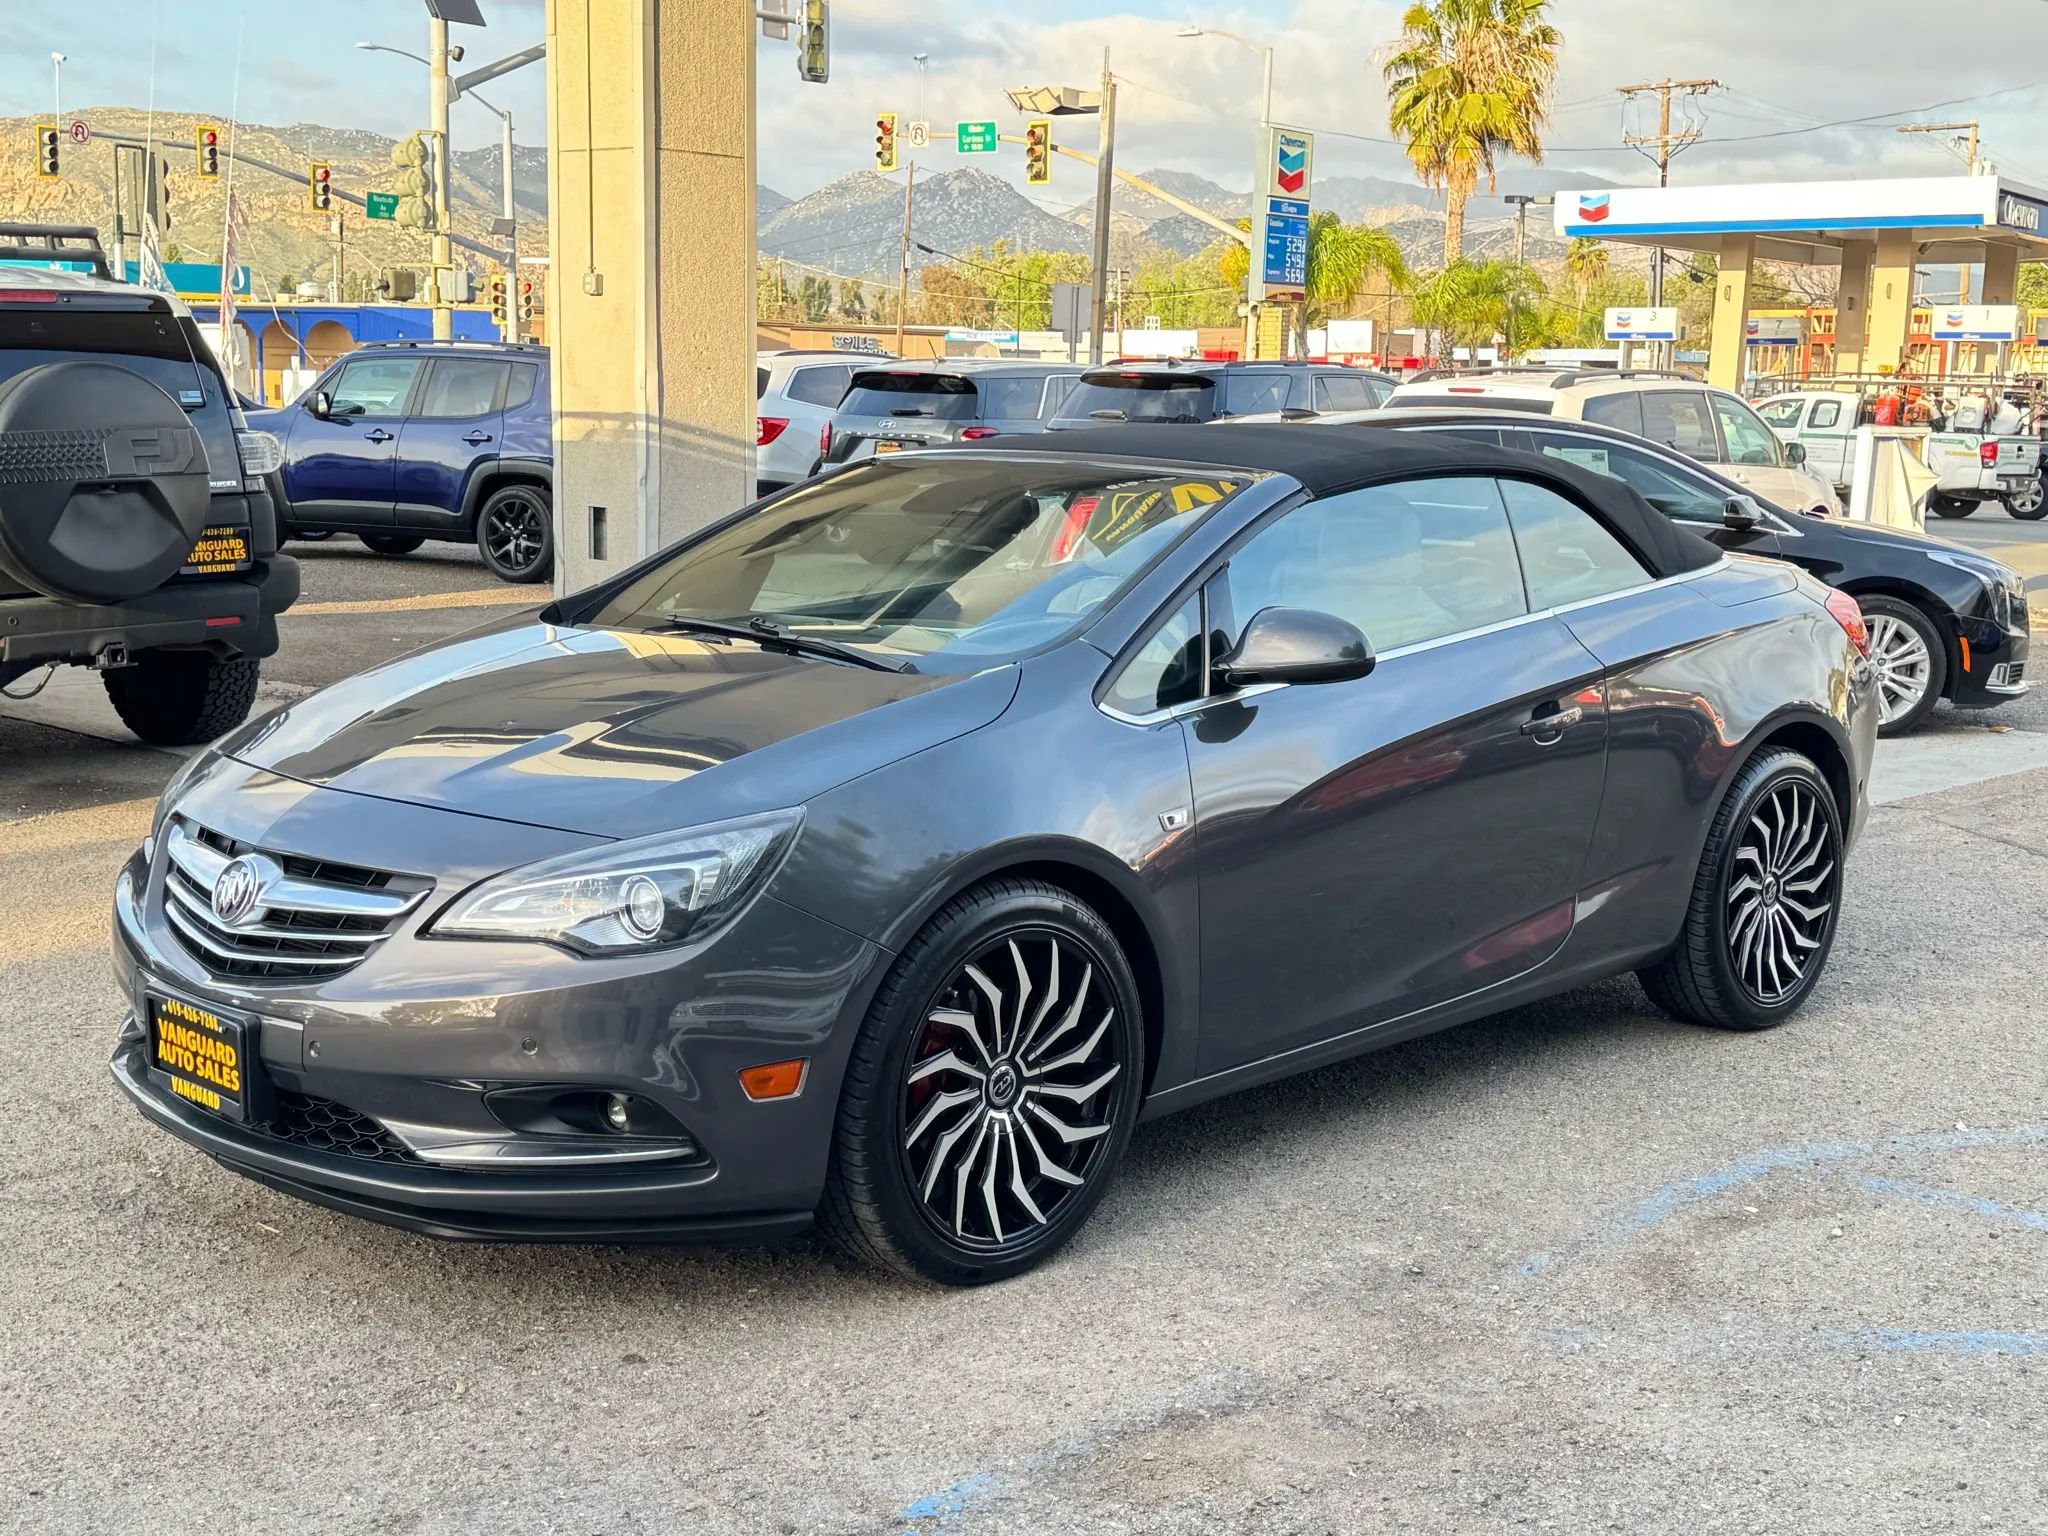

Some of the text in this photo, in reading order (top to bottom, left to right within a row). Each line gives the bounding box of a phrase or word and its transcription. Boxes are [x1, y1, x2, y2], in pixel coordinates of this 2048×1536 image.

[1649, 310, 1657, 322] 3
[1775, 319, 1783, 329] 7
[195, 539, 244, 552] NGUARD
[214, 549, 246, 561] SALES
[198, 563, 236, 573] VANGUARD
[158, 1018, 236, 1067] VANGUARD
[158, 1040, 240, 1091] AUTO SALES
[171, 1075, 220, 1110] VANGUARD
